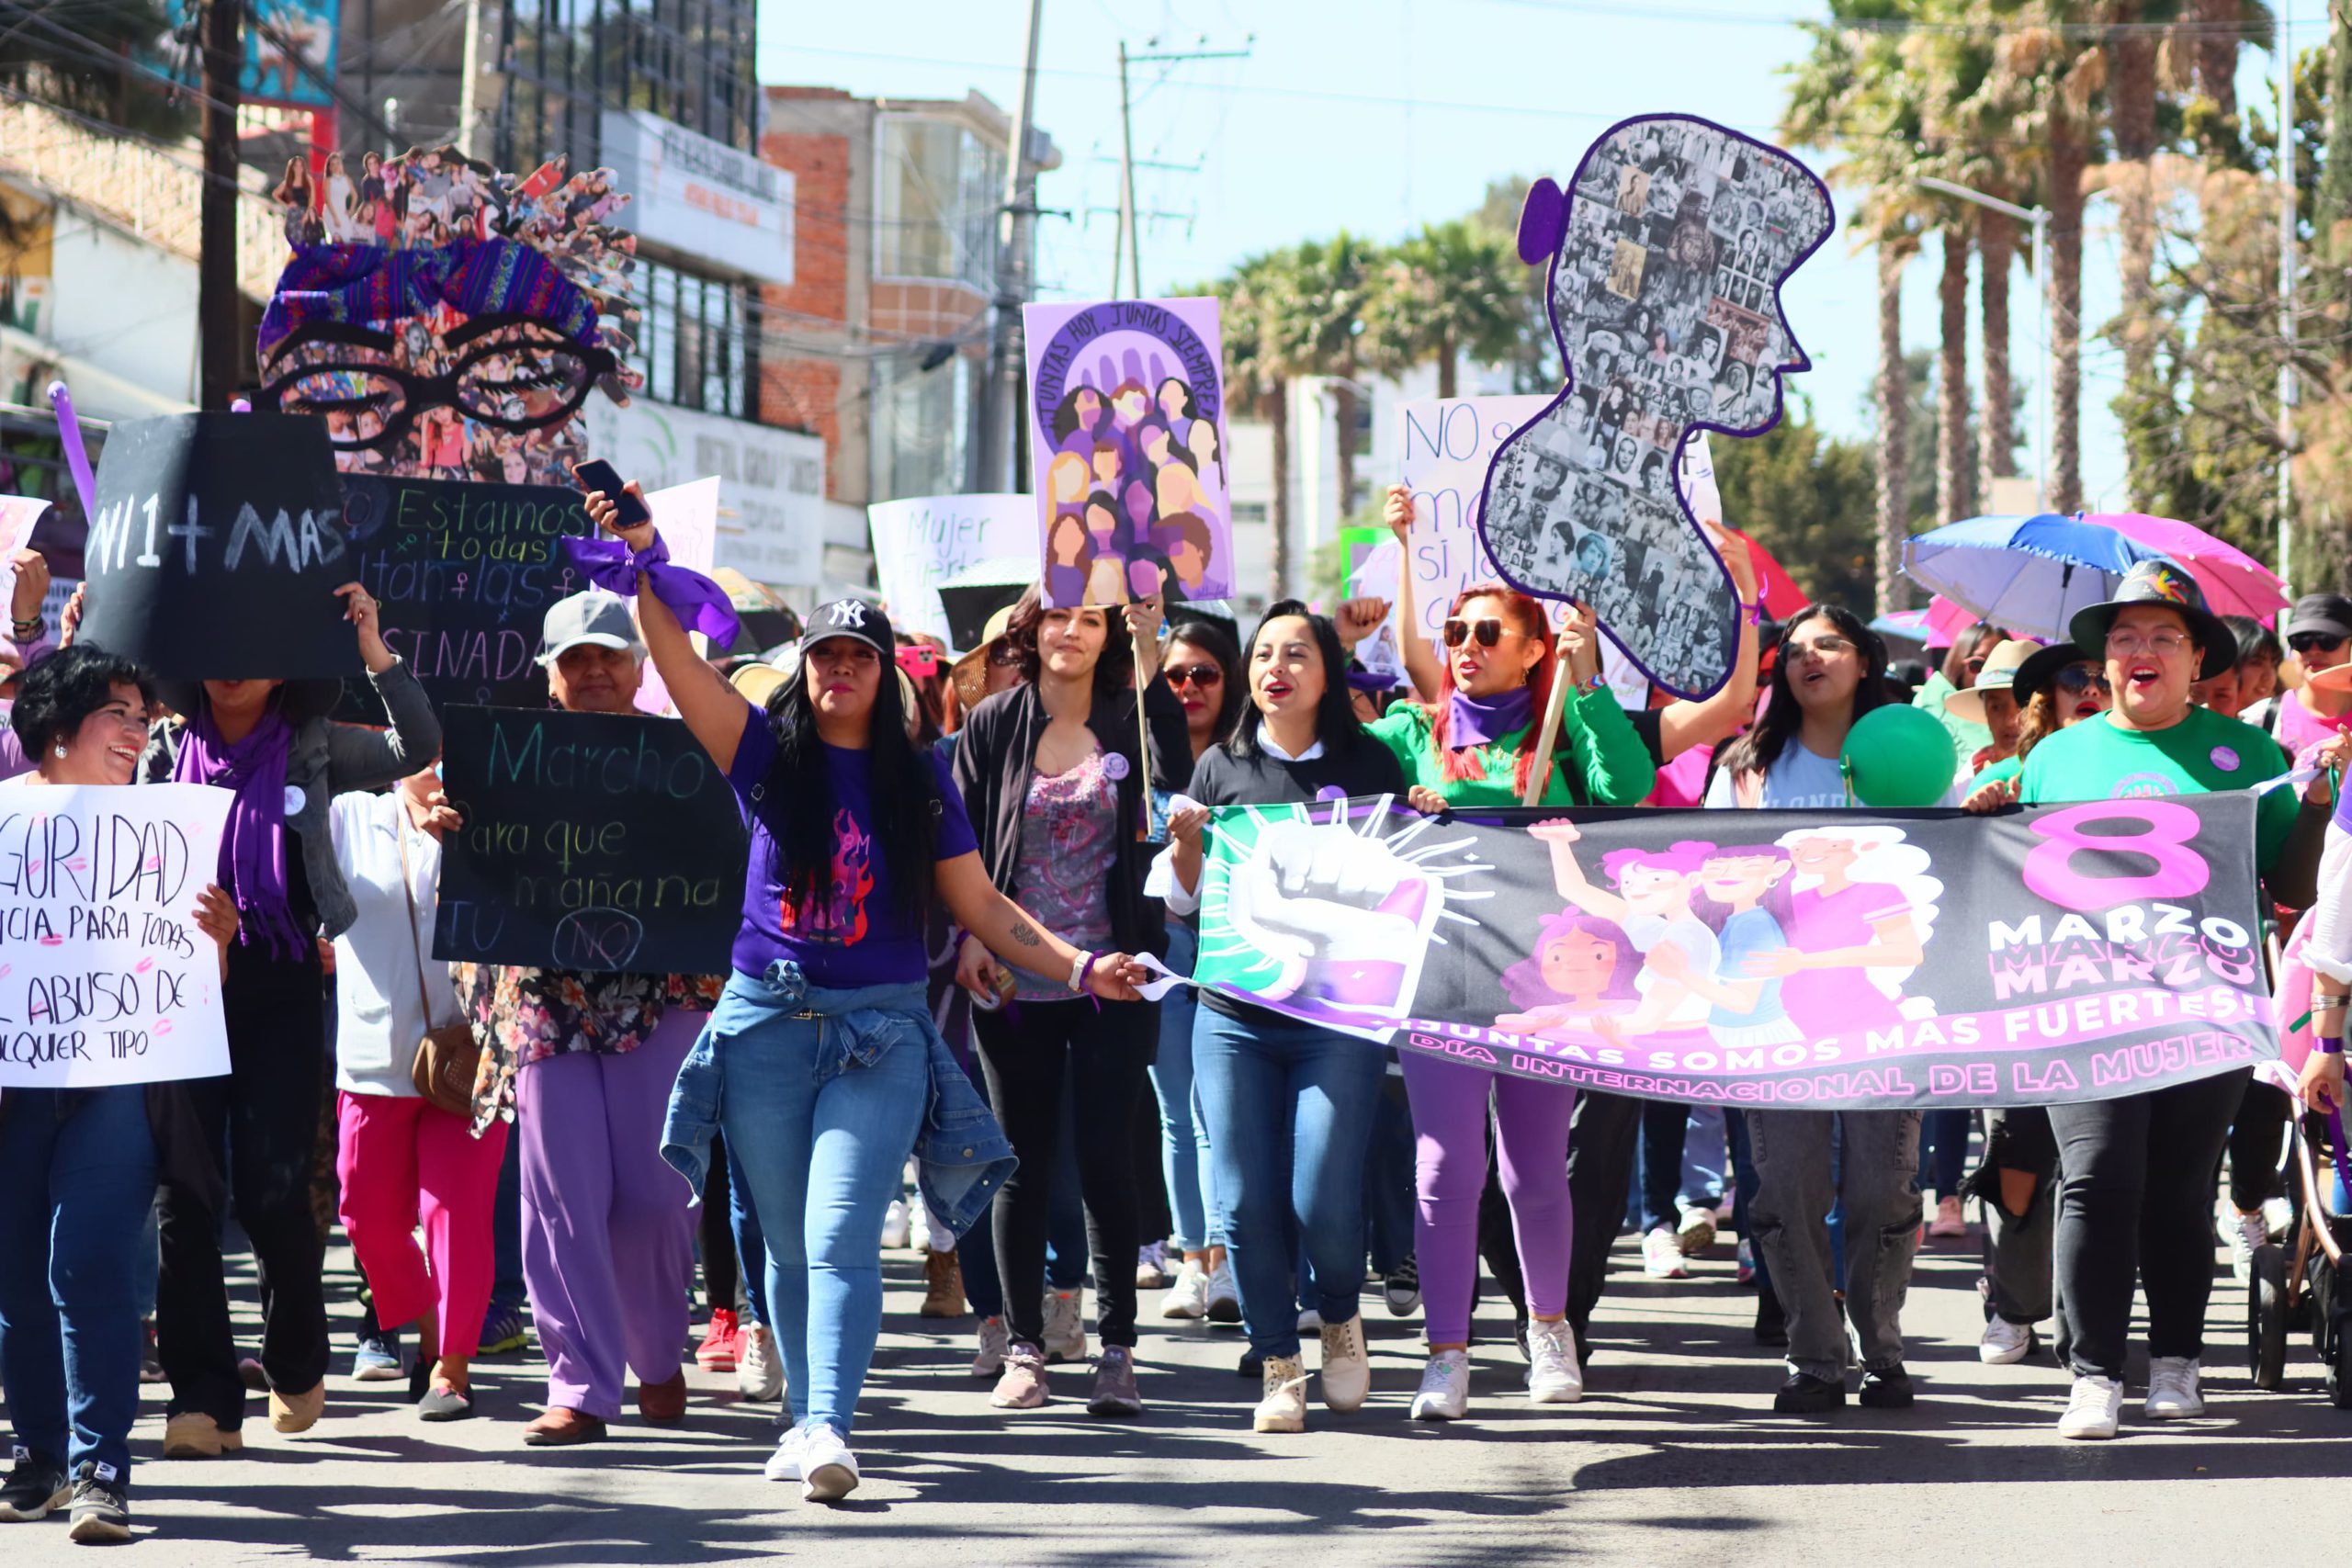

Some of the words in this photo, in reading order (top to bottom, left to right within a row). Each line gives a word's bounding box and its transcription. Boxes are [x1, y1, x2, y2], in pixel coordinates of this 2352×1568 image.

[1067, 311, 1106, 343] HOY,
[1110, 303, 1170, 335] JUNTAS
[1406, 402, 1480, 462] NO
[224, 502, 345, 574] MAS
[397, 489, 586, 536] Estamos
[906, 509, 991, 559] Mujer
[434, 529, 548, 563] todas
[473, 553, 548, 608] las
[488, 720, 706, 798] Marcho
[544, 819, 627, 874] que
[2023, 798, 2211, 911] 8
[0, 906, 53, 945] CIA
[69, 905, 129, 942] PARA
[141, 912, 195, 959] TODAS
[571, 920, 634, 963] NO
[1988, 902, 2250, 951] MARZO
[28, 969, 140, 1026] ABUSO
[156, 969, 187, 1014] DE
[1994, 952, 2256, 1000] MARZO
[103, 1030, 149, 1059] TIPO
[1647, 1037, 1841, 1071] SOMOS
[1865, 1017, 1981, 1055] MAS
[2004, 984, 2256, 1043] FUERTES!
[1511, 1054, 1917, 1103] INTERNACIONAL
[1928, 1063, 1997, 1095] DE
[2012, 1059, 2080, 1093] LA
[2090, 1031, 2253, 1087] MUJER
